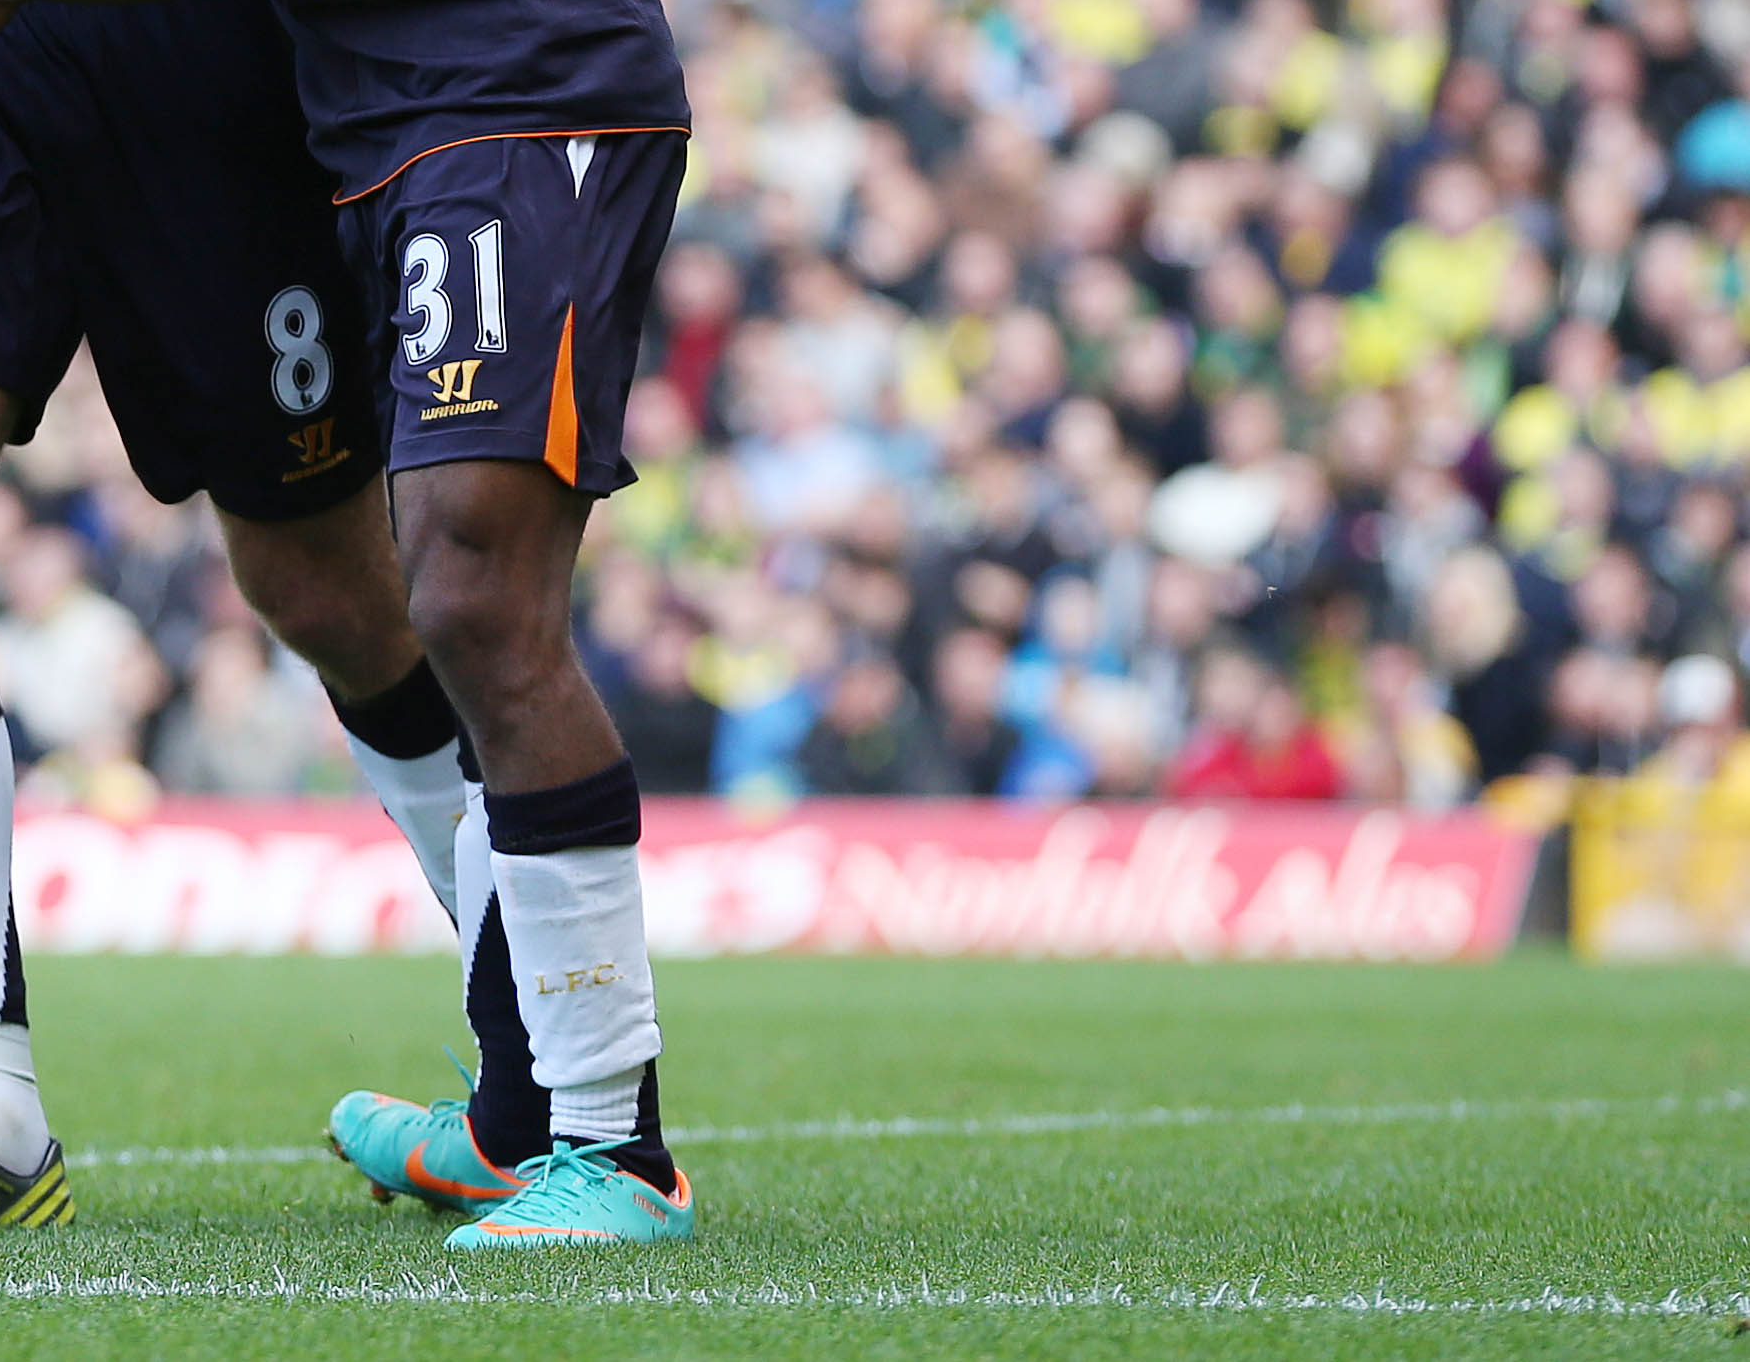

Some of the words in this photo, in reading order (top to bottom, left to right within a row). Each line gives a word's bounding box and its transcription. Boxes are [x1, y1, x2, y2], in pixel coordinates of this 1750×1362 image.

[264, 284, 335, 415] 8
[402, 219, 508, 366] 31
[534, 962, 626, 995] L.F.C.
